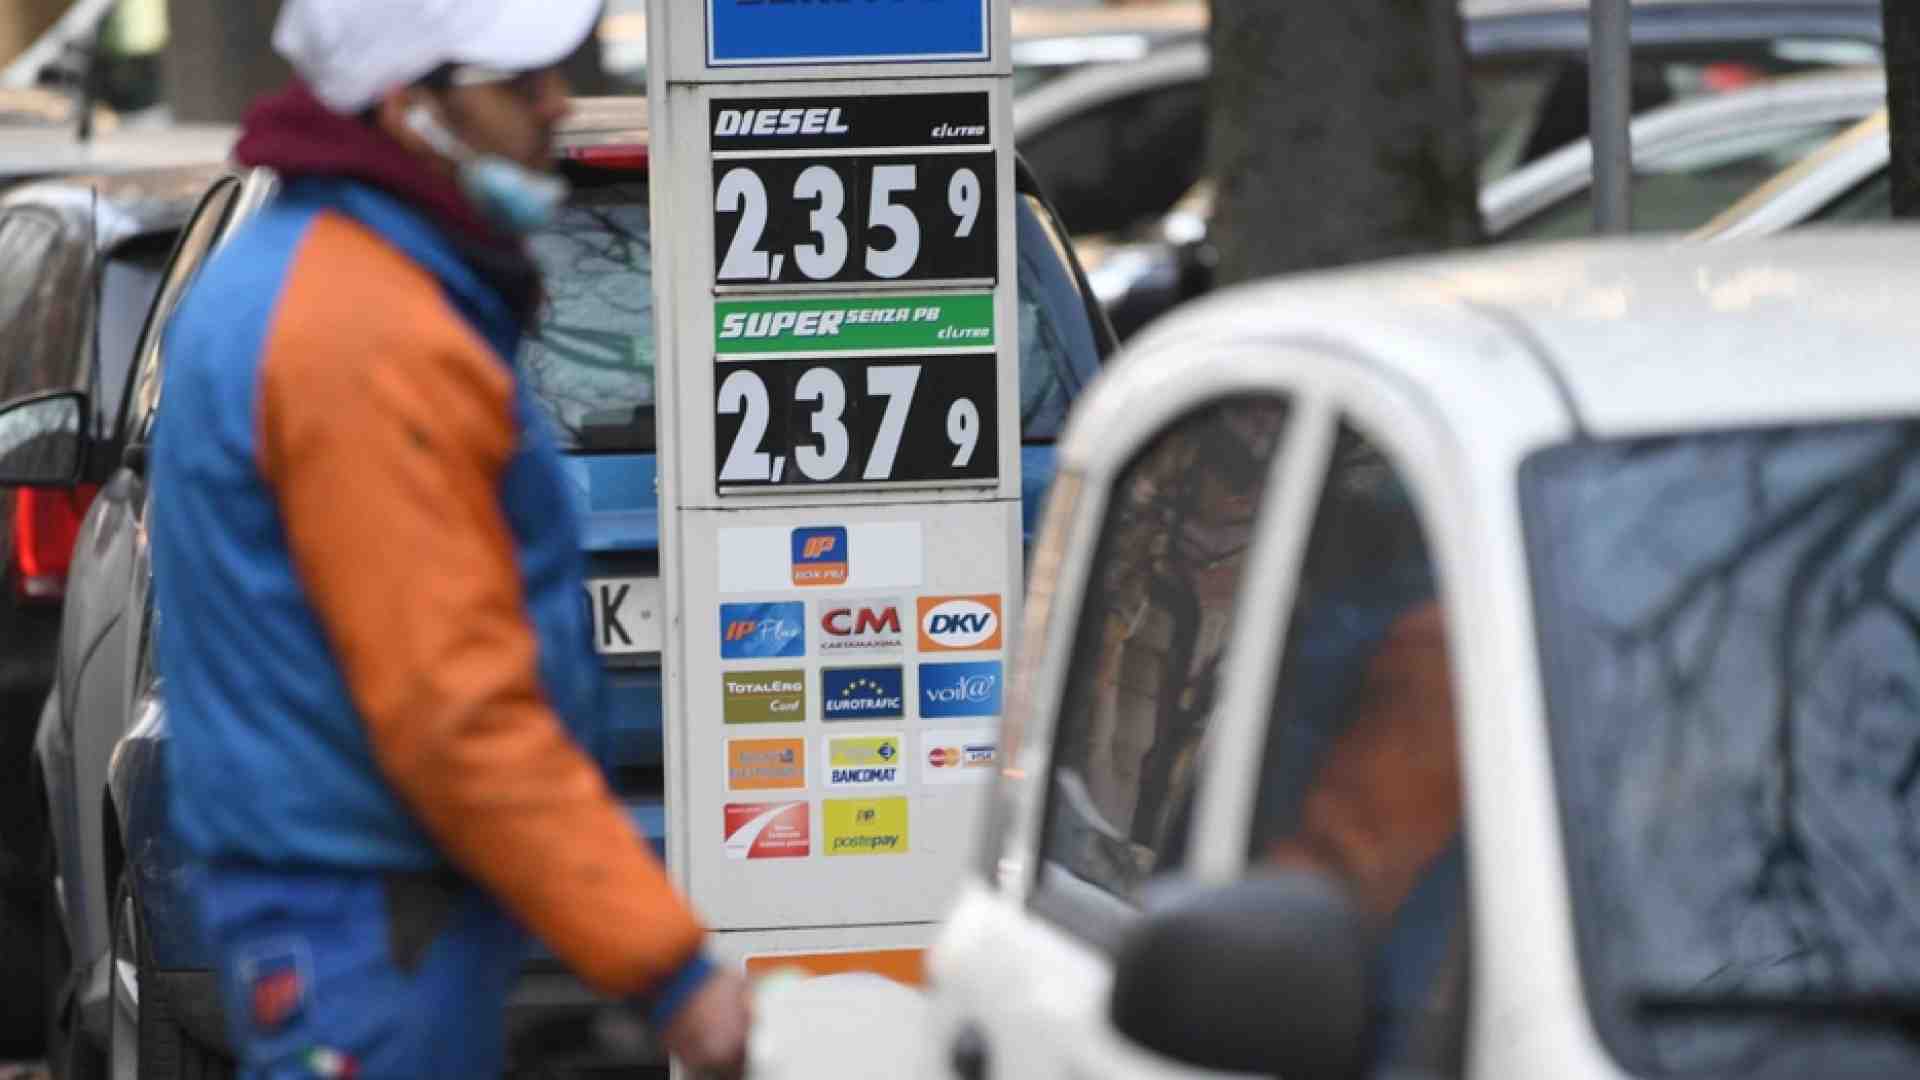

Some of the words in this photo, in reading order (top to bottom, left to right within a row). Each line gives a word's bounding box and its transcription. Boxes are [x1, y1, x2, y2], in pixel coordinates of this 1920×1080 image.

[714, 107, 849, 136] DIESEL
[719, 310, 848, 339] SUPER
[846, 307, 909, 324] SENZA
[913, 306, 941, 322] PB
[585, 583, 633, 647] K
[821, 606, 901, 636] CM
[929, 613, 991, 634] DKV
[726, 620, 755, 641] IP
[826, 697, 900, 712] EUROTRAFIC
[832, 767, 897, 784] BANCOMAT
[832, 834, 899, 851] postepay
